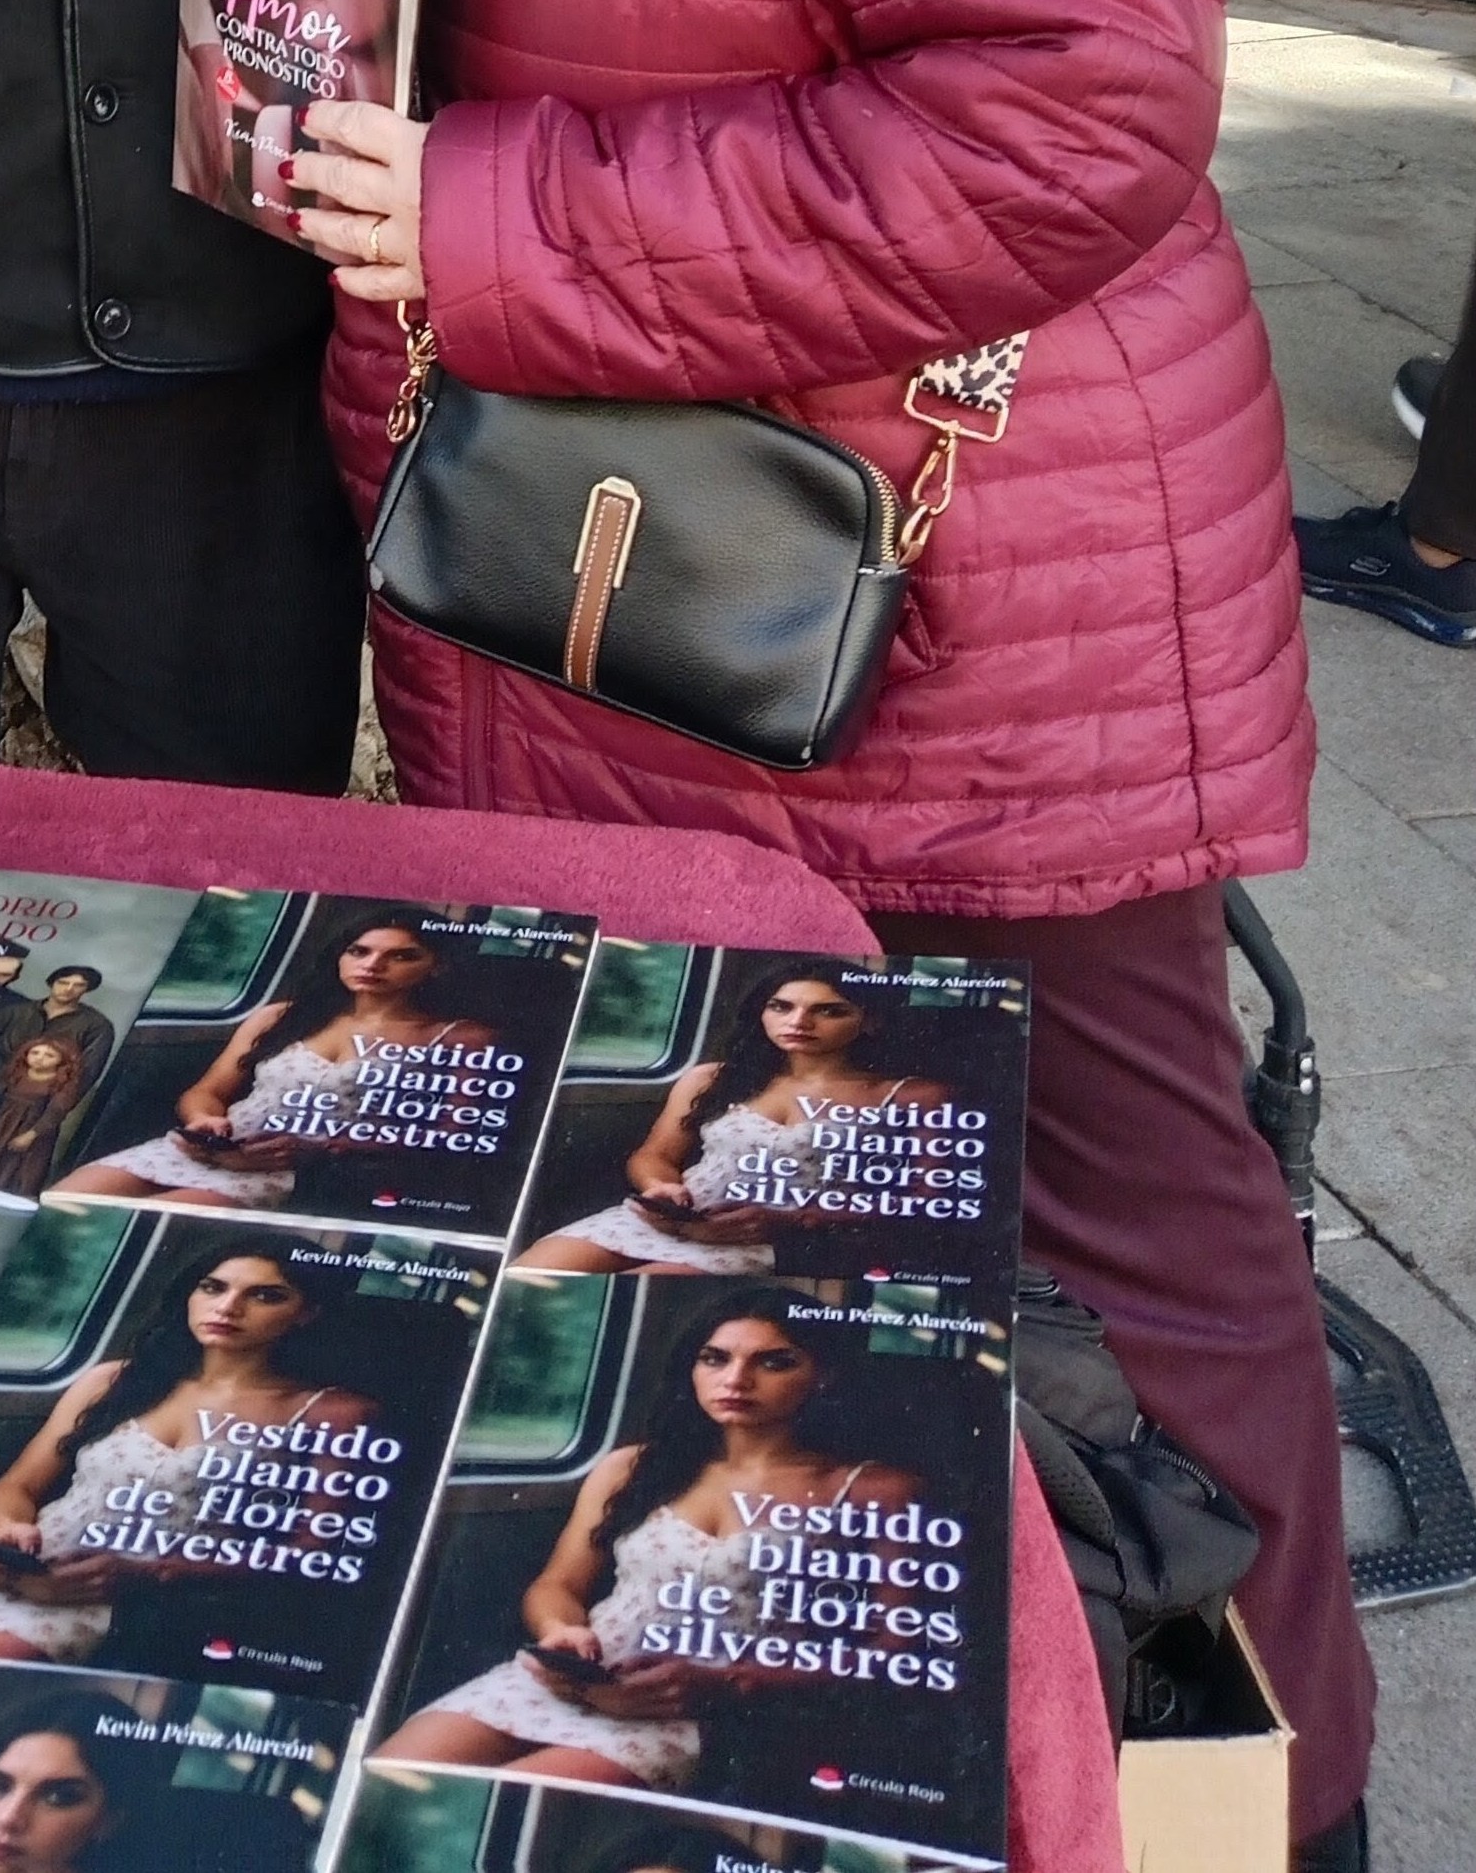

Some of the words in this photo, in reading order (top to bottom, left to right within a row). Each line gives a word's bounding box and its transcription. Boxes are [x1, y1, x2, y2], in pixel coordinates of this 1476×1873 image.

[215, 12, 288, 59] CONTRA
[290, 42, 346, 79] TODO
[223, 38, 336, 99] PRONÓSTICO
[421, 919, 465, 934] Kevin
[467, 922, 512, 937] Pérez
[512, 927, 574, 942] Alarcón
[841, 971, 888, 984] Kevin
[892, 972, 940, 987] Pérez
[941, 975, 1008, 989] Alarcón
[350, 1034, 524, 1072] Vestido
[355, 1060, 516, 1099] blanco
[281, 1083, 339, 1111] de
[355, 1088, 507, 1127] flores
[795, 1095, 987, 1130] Vestido
[263, 1110, 499, 1154] silvestres
[812, 1123, 985, 1158] blanco
[737, 1147, 799, 1178] de
[820, 1153, 985, 1189] flores
[725, 1176, 981, 1219] silvestres
[289, 1248, 341, 1266] Kevin
[345, 1252, 397, 1272] Pérez
[398, 1261, 470, 1282] Alarcón
[787, 1304, 844, 1321] Kevin
[848, 1307, 905, 1326] Pérez
[907, 1313, 987, 1334] Alarcón
[197, 1409, 402, 1464] Vestido
[196, 1445, 390, 1501] blanco
[105, 1477, 174, 1515] de
[193, 1483, 376, 1544] flores
[731, 1491, 963, 1548] Vestido
[79, 1517, 364, 1583] silvestres
[748, 1532, 961, 1592] blanco
[656, 1571, 733, 1615] de
[755, 1577, 959, 1643] flores
[640, 1615, 957, 1692] silvestres
[95, 1714, 157, 1741] Kevin
[161, 1722, 225, 1749] Pérez
[225, 1730, 315, 1762] Alarcón
